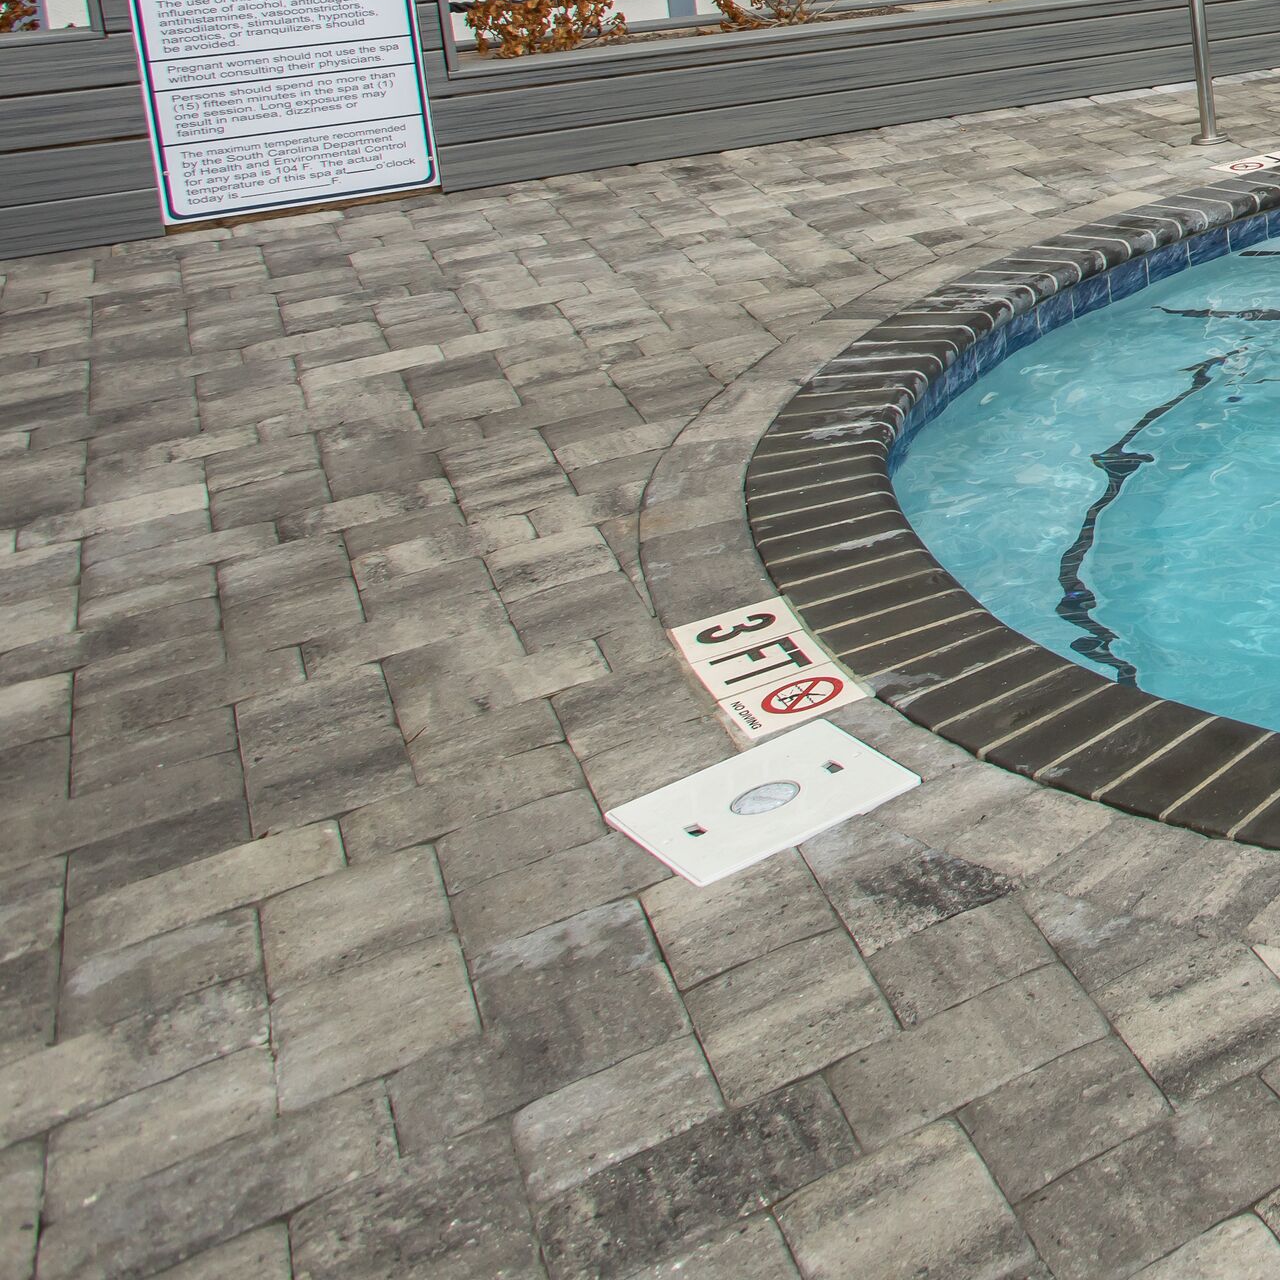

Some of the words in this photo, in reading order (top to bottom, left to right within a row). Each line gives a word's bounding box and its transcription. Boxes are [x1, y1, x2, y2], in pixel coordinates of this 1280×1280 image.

[156, 0, 182, 10] The
[186, 0, 210, 7] use
[158, 7, 218, 19] influence
[221, 5, 234, 13] of
[229, 31, 243, 39] or
[245, 23, 322, 37] tranquilizers
[325, 18, 365, 29] should
[162, 46, 180, 54] be
[166, 62, 223, 75] Pregnant
[226, 58, 269, 68] women
[272, 52, 311, 64] should
[314, 50, 332, 59] not
[336, 49, 356, 57] use
[359, 46, 376, 54] the
[379, 44, 399, 53] spa
[168, 72, 216, 85] without
[219, 66, 285, 79] consulting
[287, 62, 316, 72] their
[171, 91, 226, 103] Persons
[229, 84, 272, 97] should
[275, 80, 314, 92] spend
[317, 79, 333, 87] no
[336, 75, 367, 84] more
[369, 72, 396, 81] than
[173, 102, 200, 113] (15)
[202, 98, 243, 109] fifteen
[246, 92, 297, 104] minutes
[300, 90, 311, 98] in
[314, 87, 334, 96] the
[337, 85, 359, 94] spa
[362, 82, 374, 90] at
[377, 80, 394, 90] (1)
[174, 112, 199, 121] one
[259, 101, 292, 111] Long
[295, 94, 358, 107] exposures
[361, 90, 387, 99] may
[175, 118, 212, 130] result
[216, 117, 228, 125] in
[283, 104, 343, 117] dizziness
[176, 126, 225, 138] fainting
[180, 151, 203, 160] The
[206, 144, 261, 157] maximum
[264, 135, 330, 149] temperature
[332, 124, 406, 140] recommended
[182, 161, 199, 170] by
[201, 158, 222, 167] the
[226, 151, 264, 163] South
[266, 145, 319, 158] Carolina
[322, 135, 393, 151] Department
[183, 169, 196, 178] of
[200, 163, 242, 176] Health
[246, 160, 270, 170] and
[273, 148, 361, 166] Environmental
[364, 141, 407, 154] Control
[184, 179, 203, 188] for
[206, 175, 231, 185] any
[234, 172, 257, 182] spa
[275, 164, 298, 175] 104
[320, 160, 344, 169] The
[347, 153, 382, 165] actual
[186, 180, 265, 197] temperature
[268, 176, 280, 185] of
[283, 174, 306, 183] this
[309, 170, 332, 180] spa
[335, 167, 346, 176] at
[376, 158, 415, 170] o'clock
[187, 194, 225, 206] today
[228, 192, 239, 200] is
[696, 613, 776, 644] 3
[708, 636, 813, 686] FT
[730, 700, 746, 711] NO
[738, 709, 762, 730] DIVING
